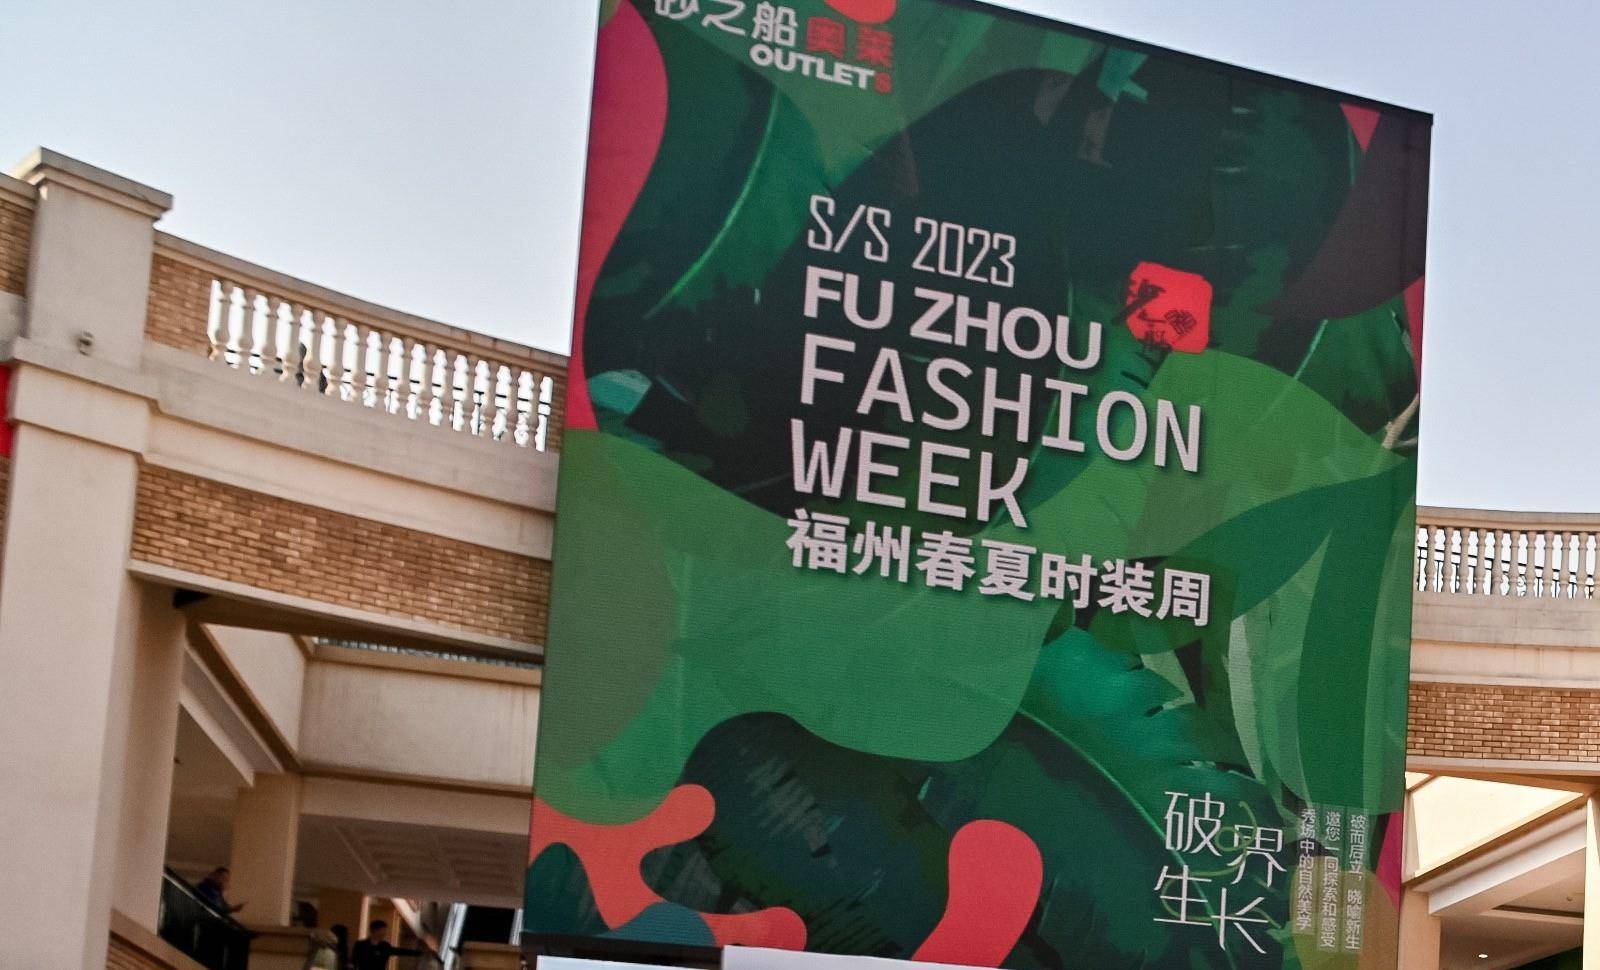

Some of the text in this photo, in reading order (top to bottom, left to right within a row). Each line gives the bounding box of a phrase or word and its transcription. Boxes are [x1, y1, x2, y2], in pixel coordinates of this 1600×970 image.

[807, 194, 1016, 288] S/S 2023
[803, 264, 894, 330] FU
[909, 286, 1102, 370] ZHOU
[800, 333, 1202, 473] FASHION
[791, 418, 1029, 529] WEEK
[785, 507, 1211, 627] 福州春夏时装周
